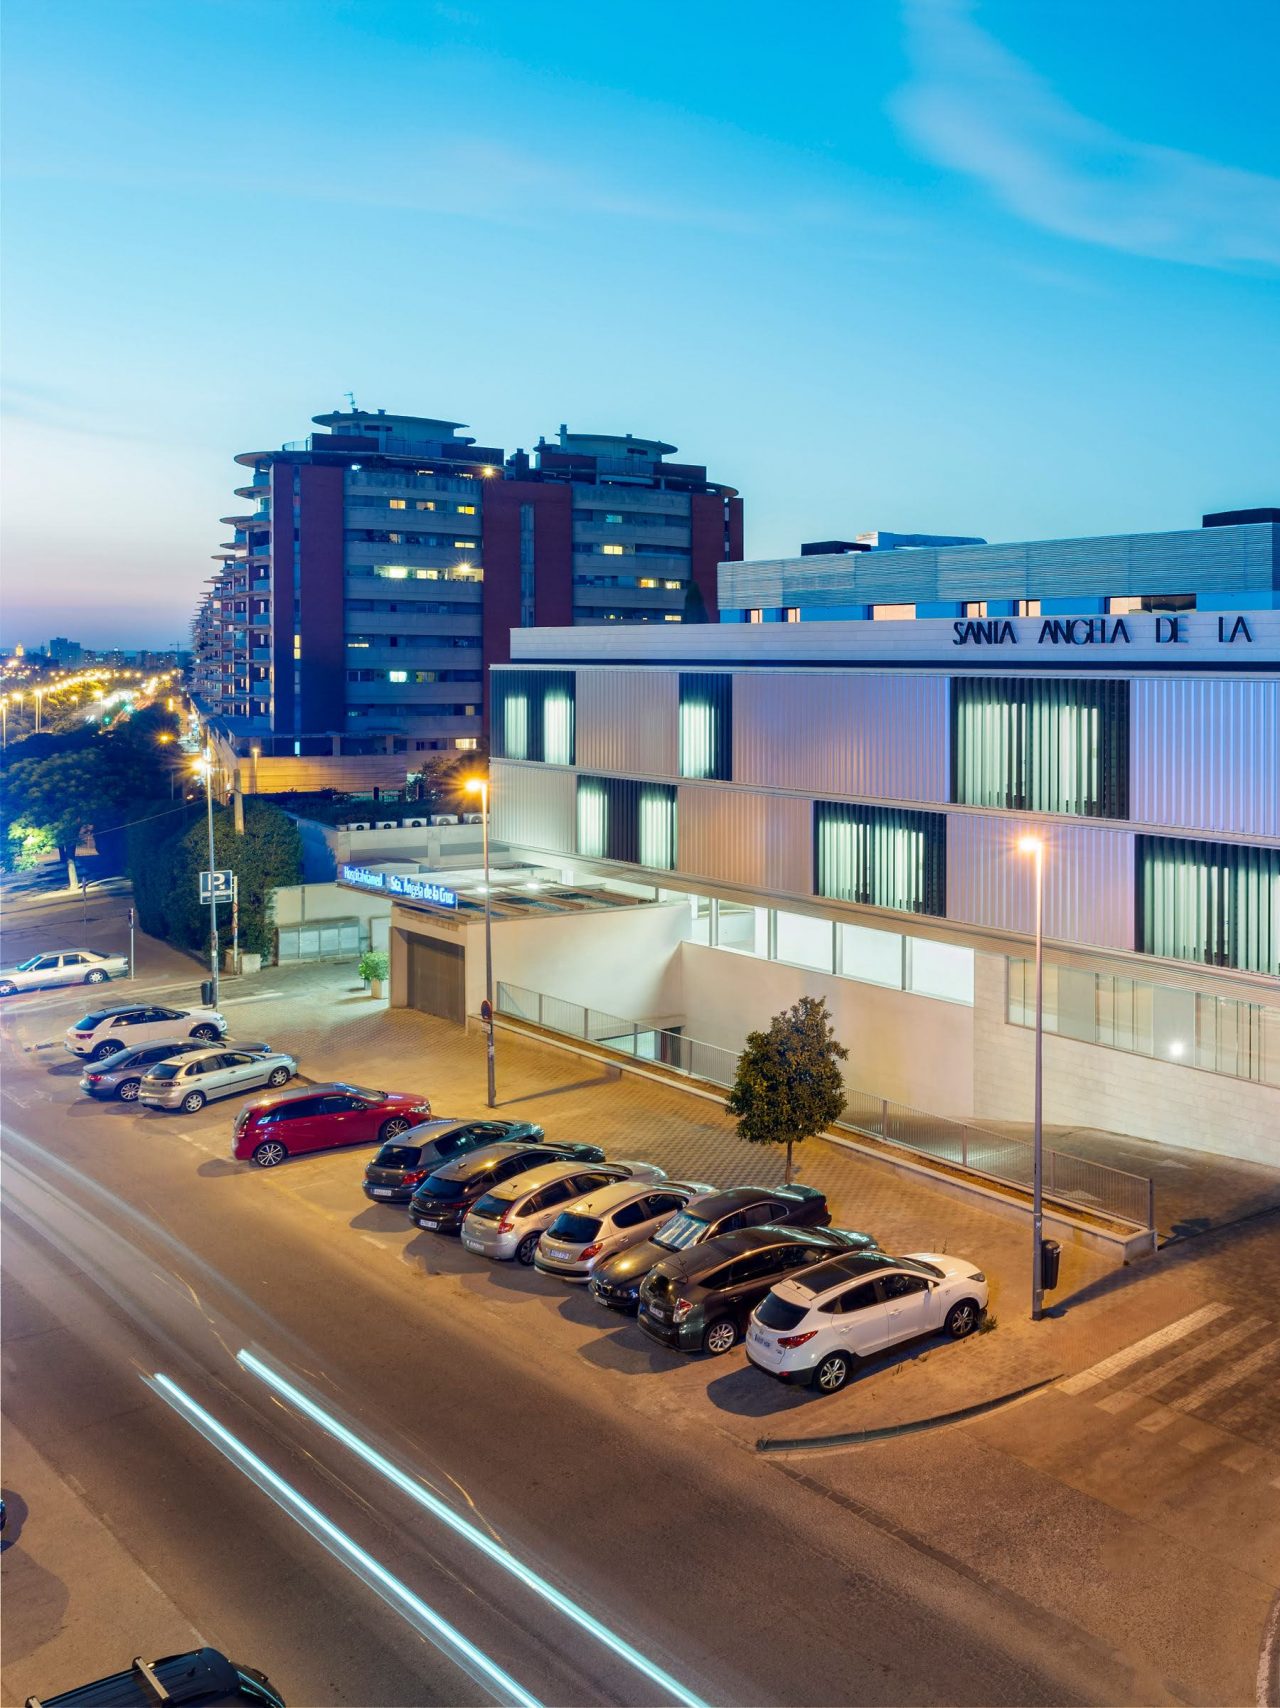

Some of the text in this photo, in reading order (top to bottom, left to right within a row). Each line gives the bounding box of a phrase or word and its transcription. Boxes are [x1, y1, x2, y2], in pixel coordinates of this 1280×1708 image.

[953, 620, 1017, 645] SANTA
[1038, 618, 1130, 645] ANGELA
[1155, 616, 1189, 643] DE
[1218, 616, 1252, 643] LA
[208, 873, 225, 891] P
[424, 883, 433, 899] de
[432, 885, 440, 901] la
[439, 888, 454, 904] Cruz
